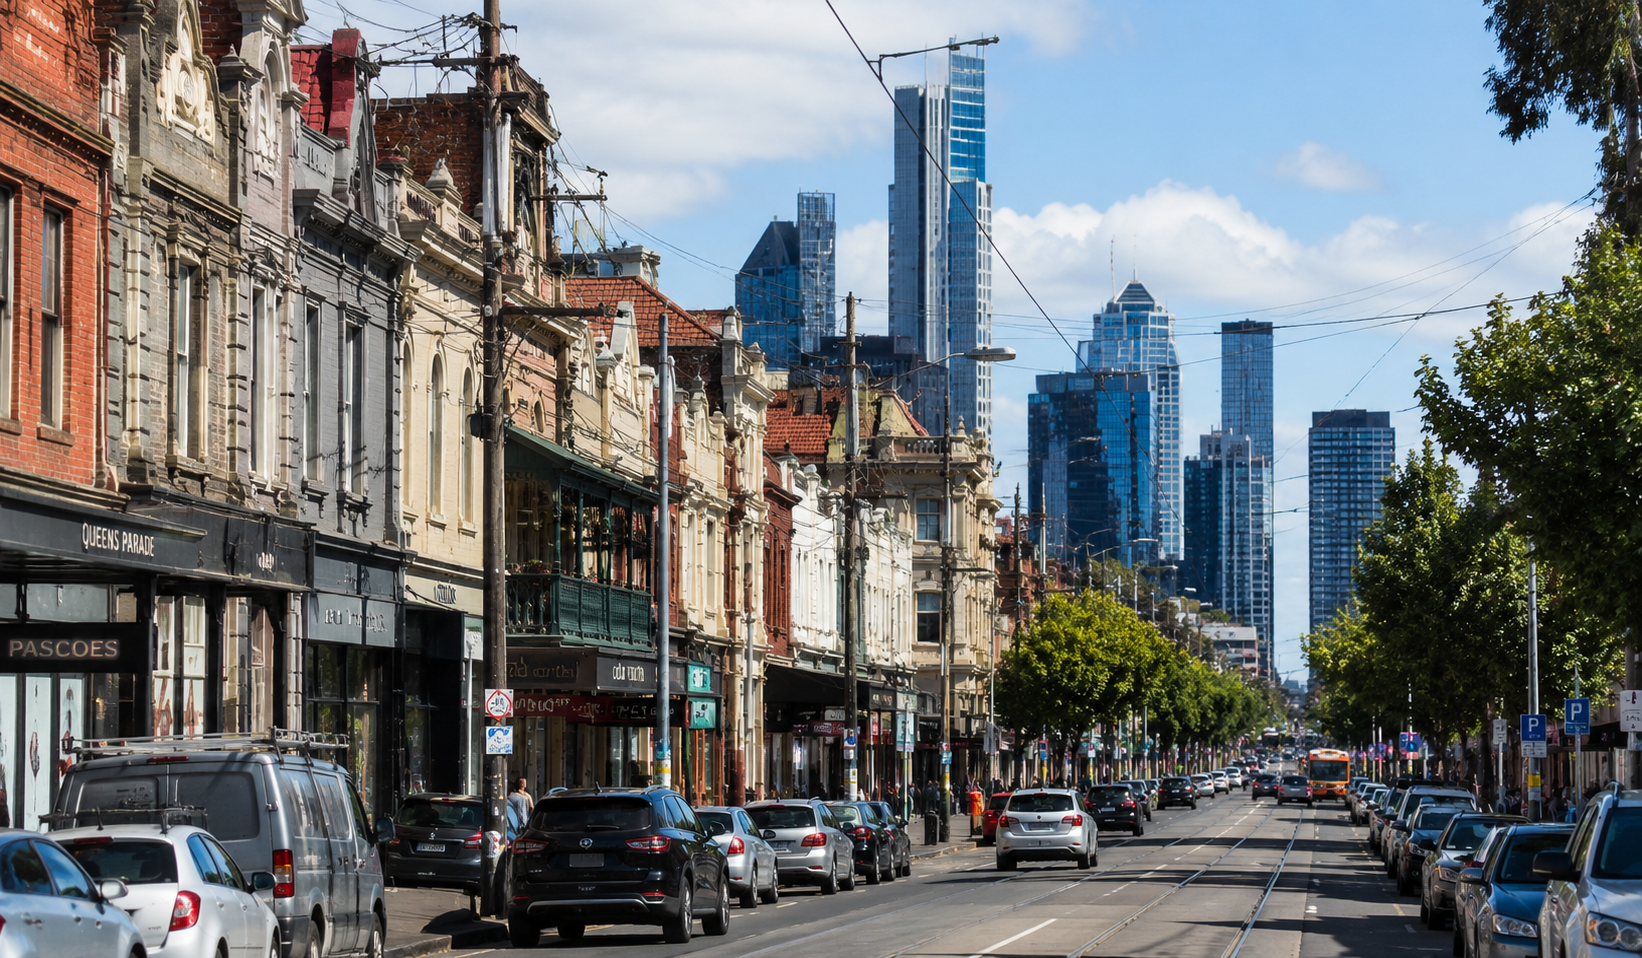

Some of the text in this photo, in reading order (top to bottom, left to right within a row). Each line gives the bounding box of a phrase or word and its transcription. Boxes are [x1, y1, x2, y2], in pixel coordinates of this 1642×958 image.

[82, 522, 154, 557] QUEENS PARADE
[9, 639, 118, 657] PASCOES
[1571, 702, 1583, 721] P
[1528, 717, 1539, 732] P
